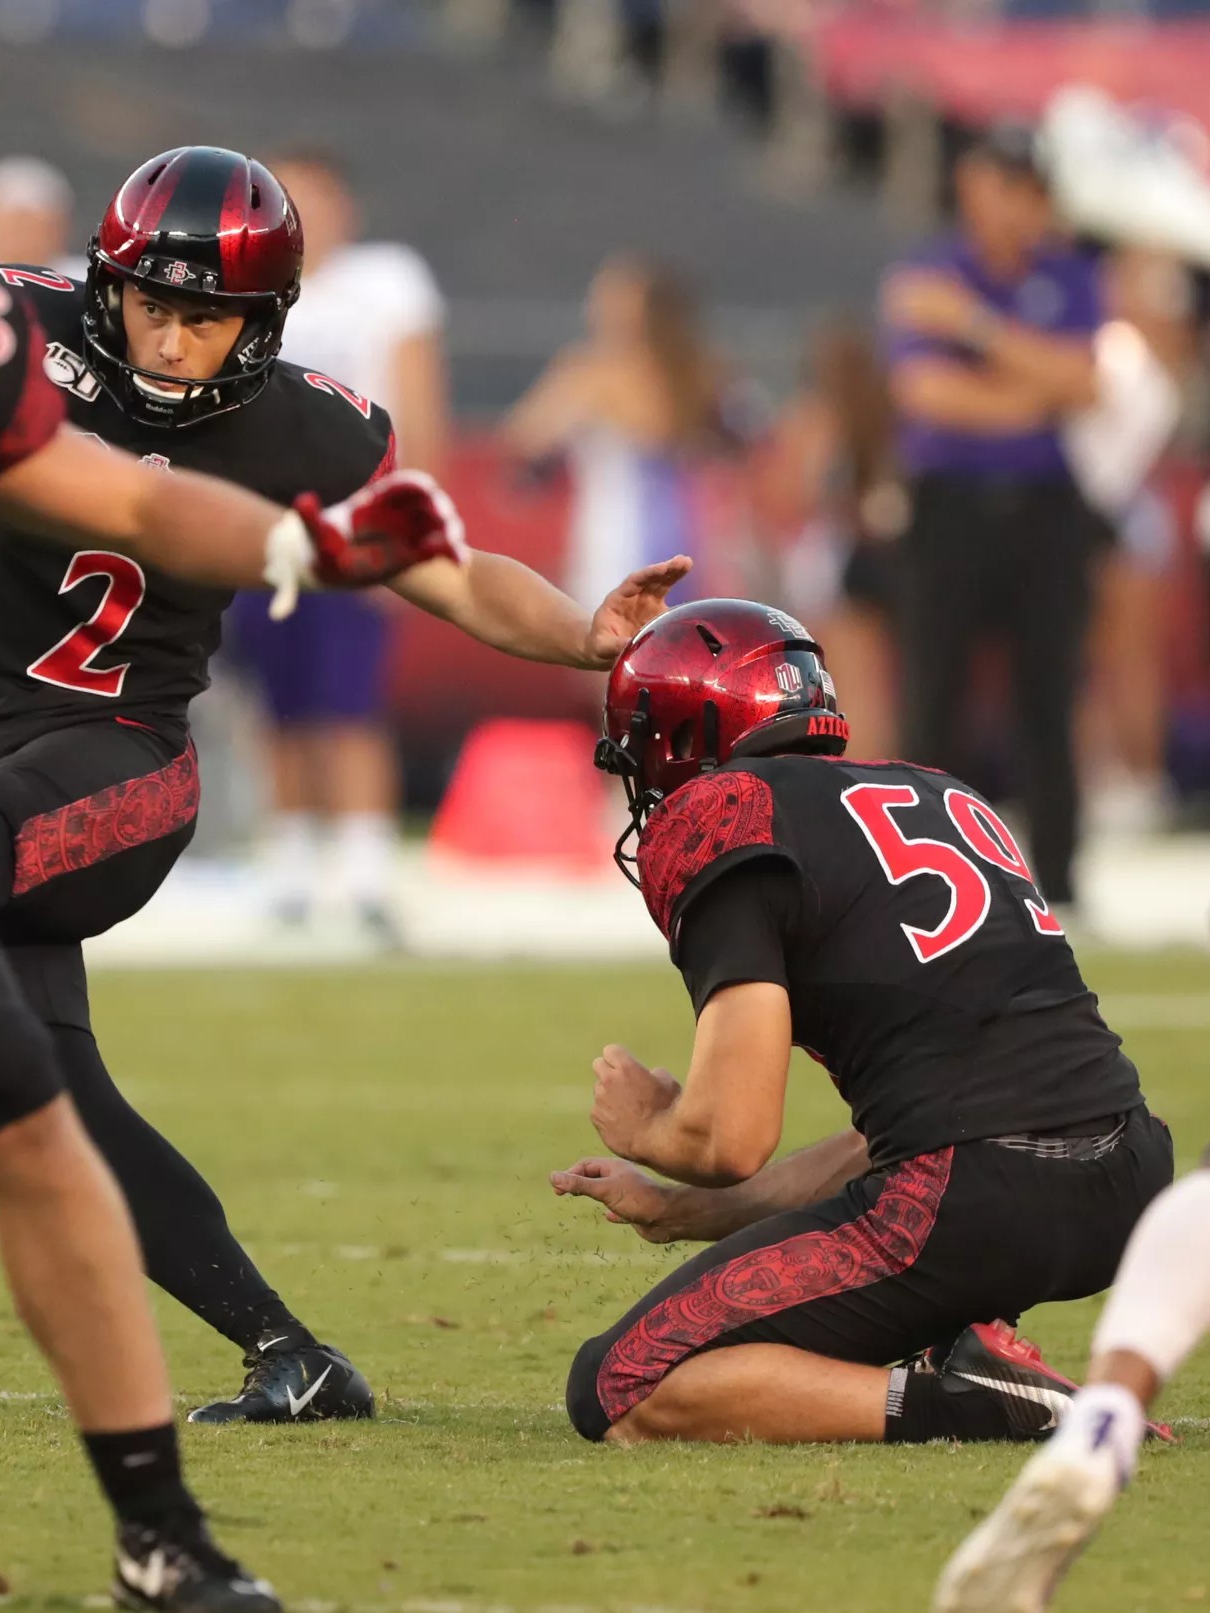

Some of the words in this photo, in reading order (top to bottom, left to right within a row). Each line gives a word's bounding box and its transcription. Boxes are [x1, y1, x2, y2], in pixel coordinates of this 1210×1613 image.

[303, 372, 371, 419] 2
[26, 550, 146, 697] 2
[840, 782, 1065, 964] 59
